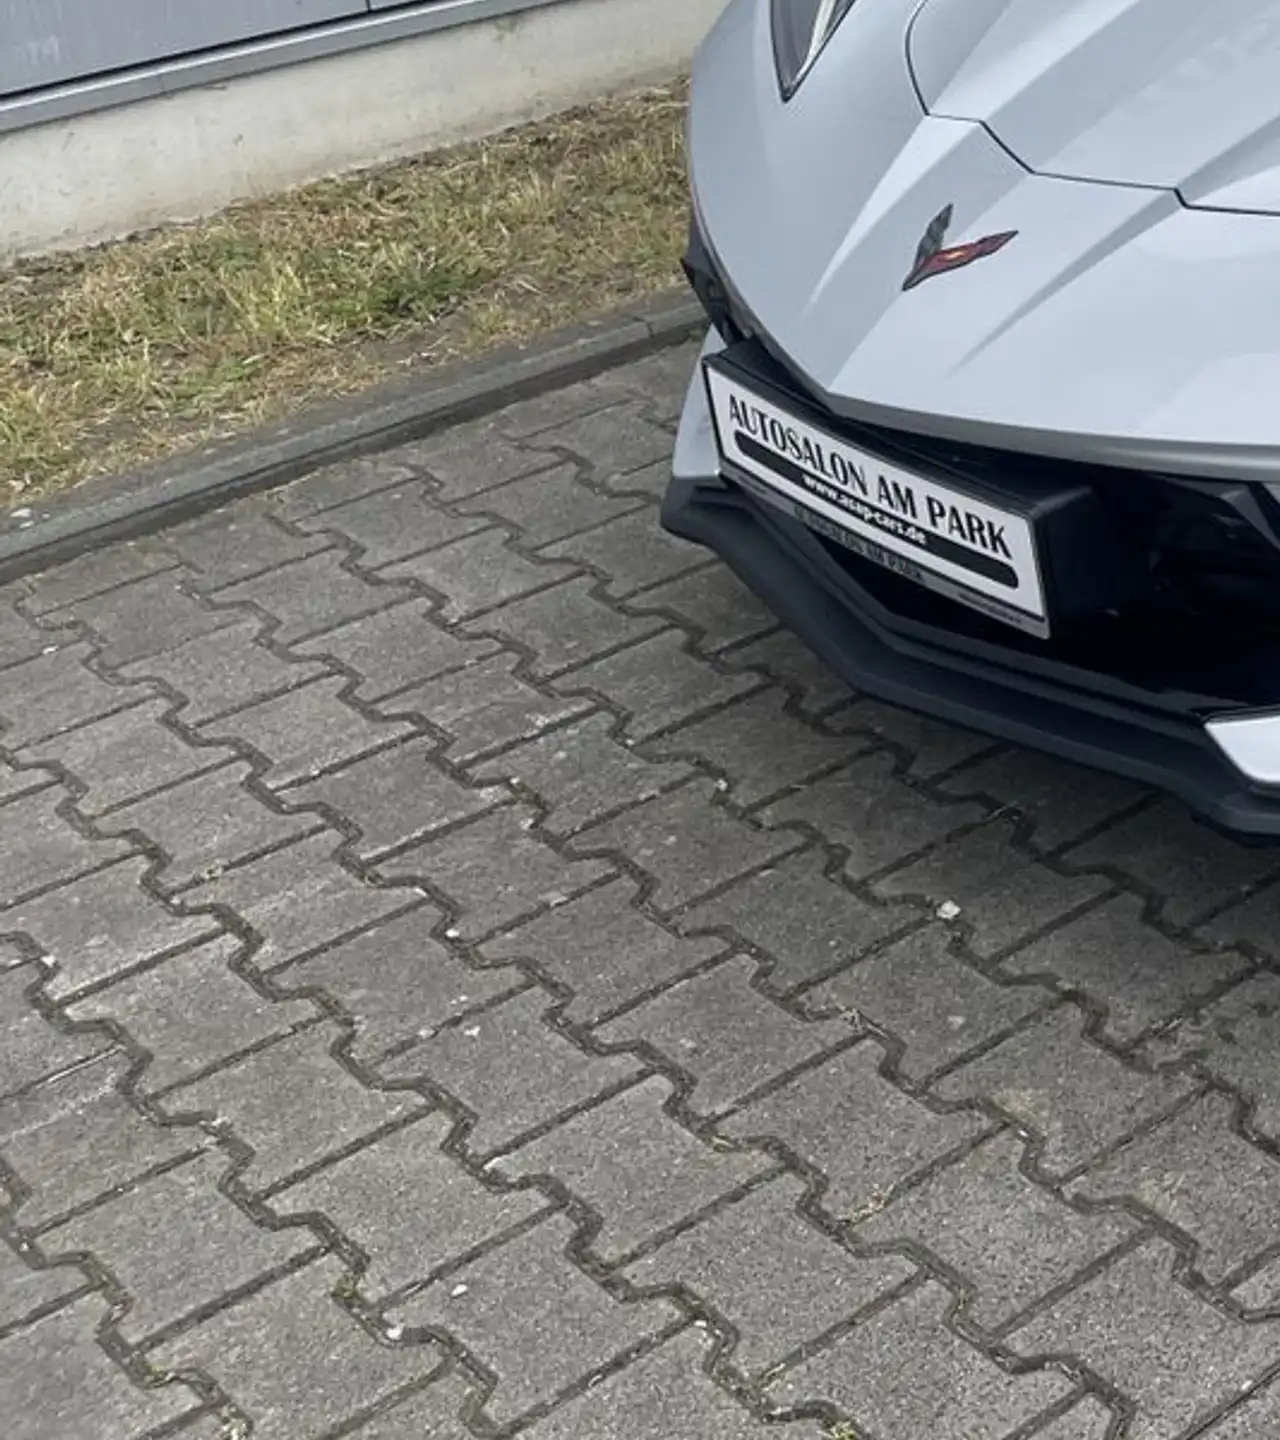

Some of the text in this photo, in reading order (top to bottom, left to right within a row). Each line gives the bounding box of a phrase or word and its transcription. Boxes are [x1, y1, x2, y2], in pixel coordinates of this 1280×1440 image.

[728, 393, 869, 497] AUTOSALON
[876, 475, 918, 521] AM
[926, 495, 1013, 559] PARK
